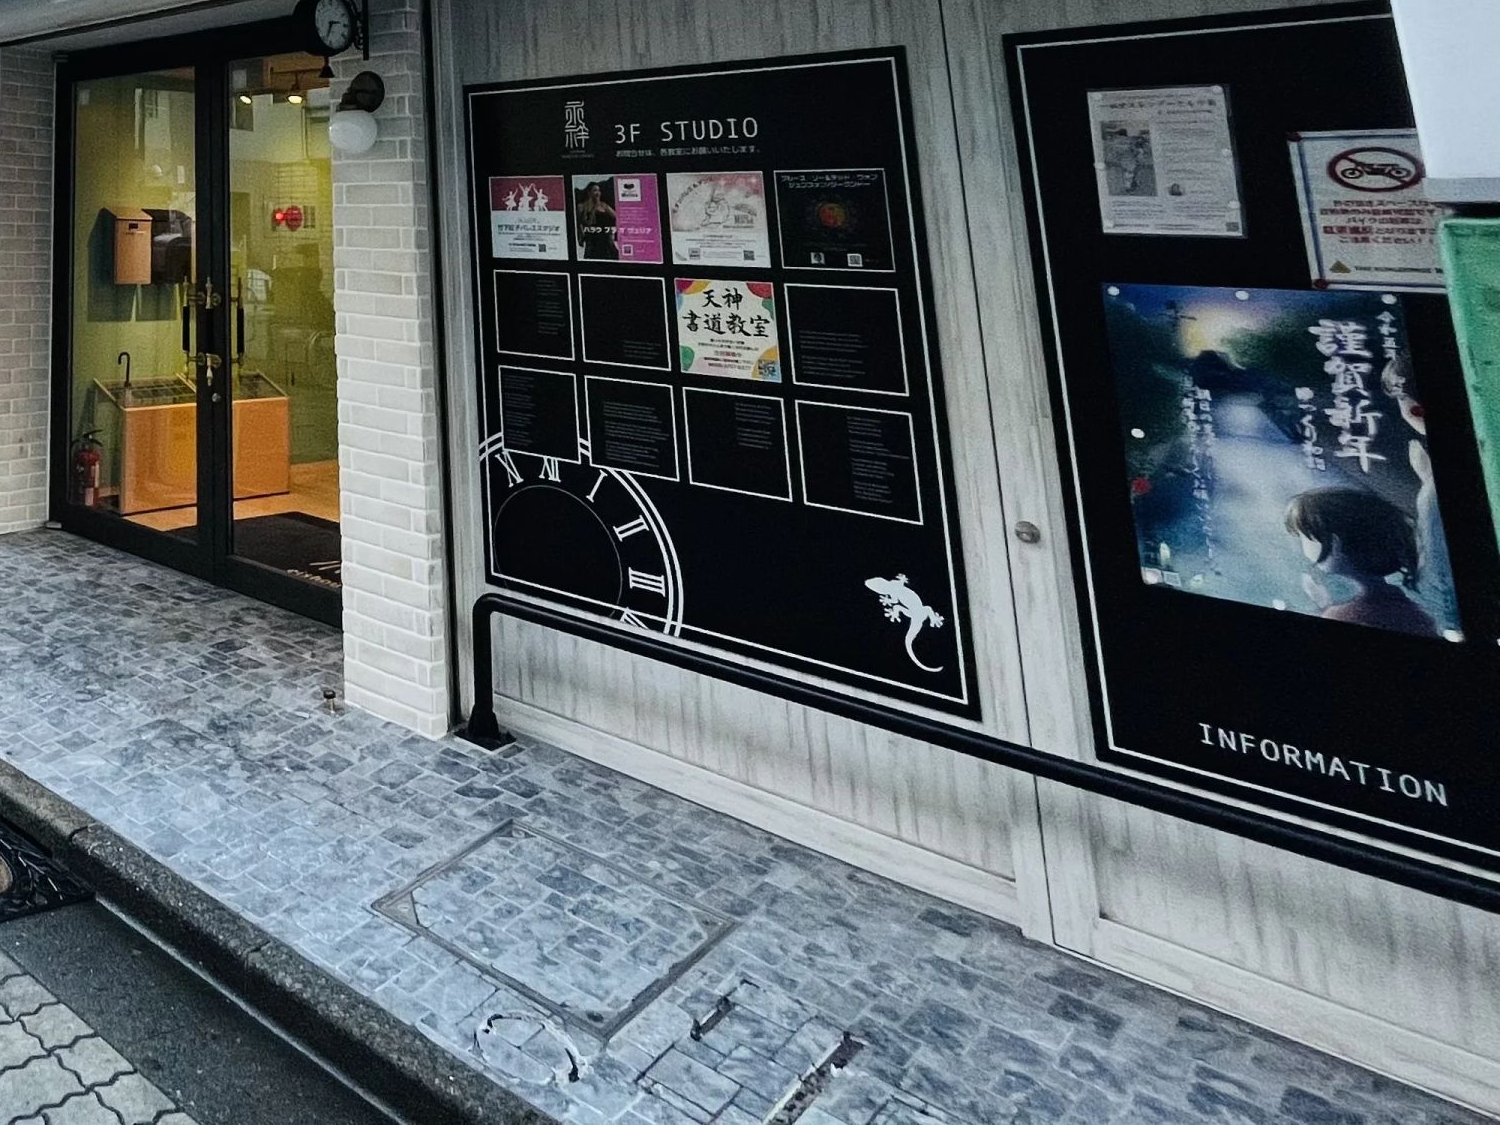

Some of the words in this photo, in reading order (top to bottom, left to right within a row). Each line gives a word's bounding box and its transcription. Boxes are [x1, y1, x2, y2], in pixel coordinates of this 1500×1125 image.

[614, 123, 641, 144] 3F
[660, 117, 758, 142] STUDIO
[701, 287, 743, 310] 天神
[682, 309, 770, 338] 書道教室
[1308, 318, 1388, 474] 謹賀新年
[1198, 722, 1448, 807] INFORMATION
